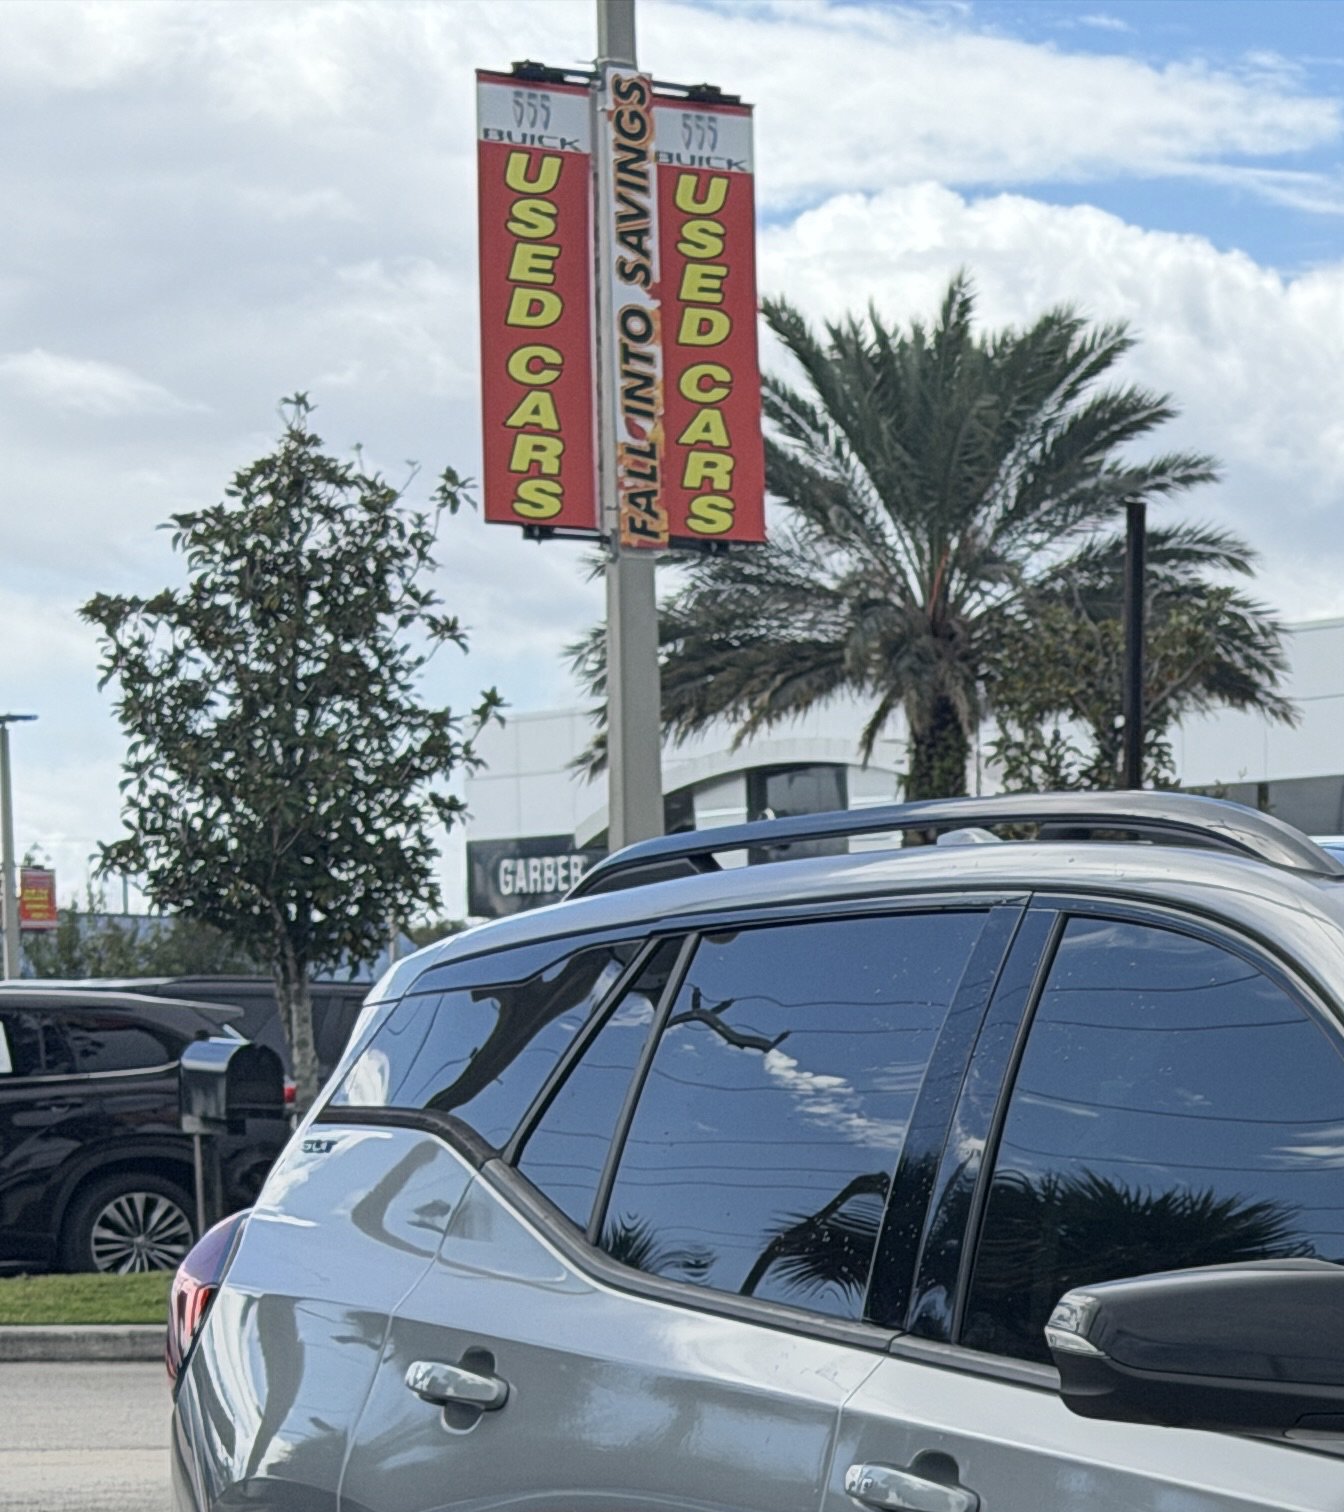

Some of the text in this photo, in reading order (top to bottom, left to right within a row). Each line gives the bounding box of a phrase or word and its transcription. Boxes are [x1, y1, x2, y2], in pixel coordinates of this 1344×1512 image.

[483, 127, 581, 151] BUICK
[611, 73, 662, 540] FALL INTO SAVINGS
[655, 151, 747, 171] BUICK
[503, 151, 565, 521] USED CARS
[674, 173, 735, 535] USED CARS
